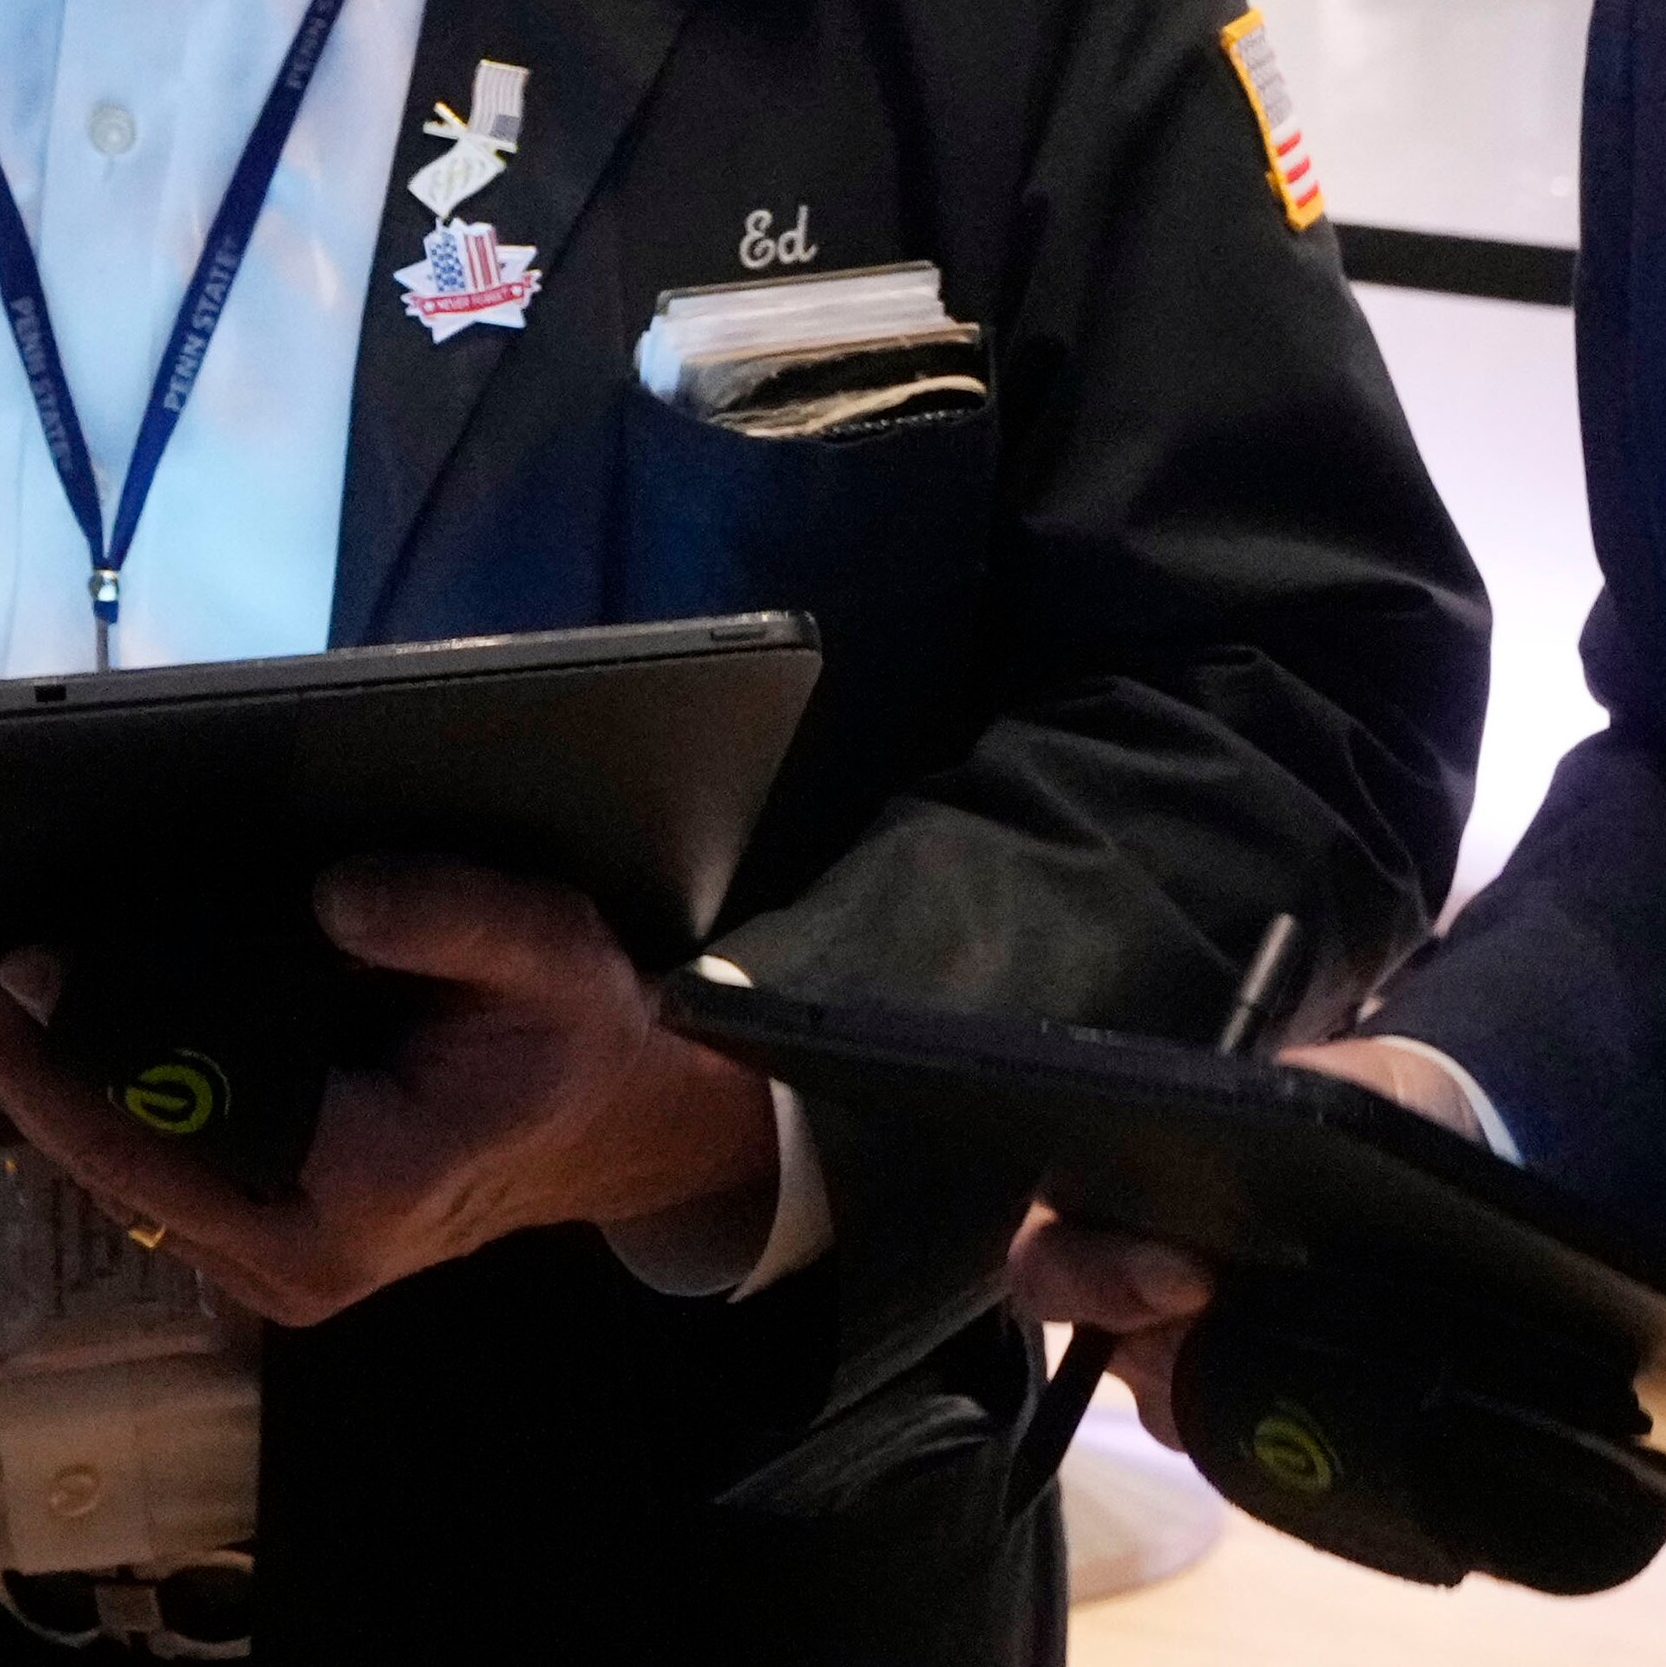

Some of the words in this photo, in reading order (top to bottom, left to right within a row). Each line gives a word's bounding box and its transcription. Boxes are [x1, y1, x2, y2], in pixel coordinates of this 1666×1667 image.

[739, 205, 817, 268] Ed
[10, 296, 46, 375] PENN
[163, 334, 206, 412] PENN
[192, 248, 239, 330] STATE
